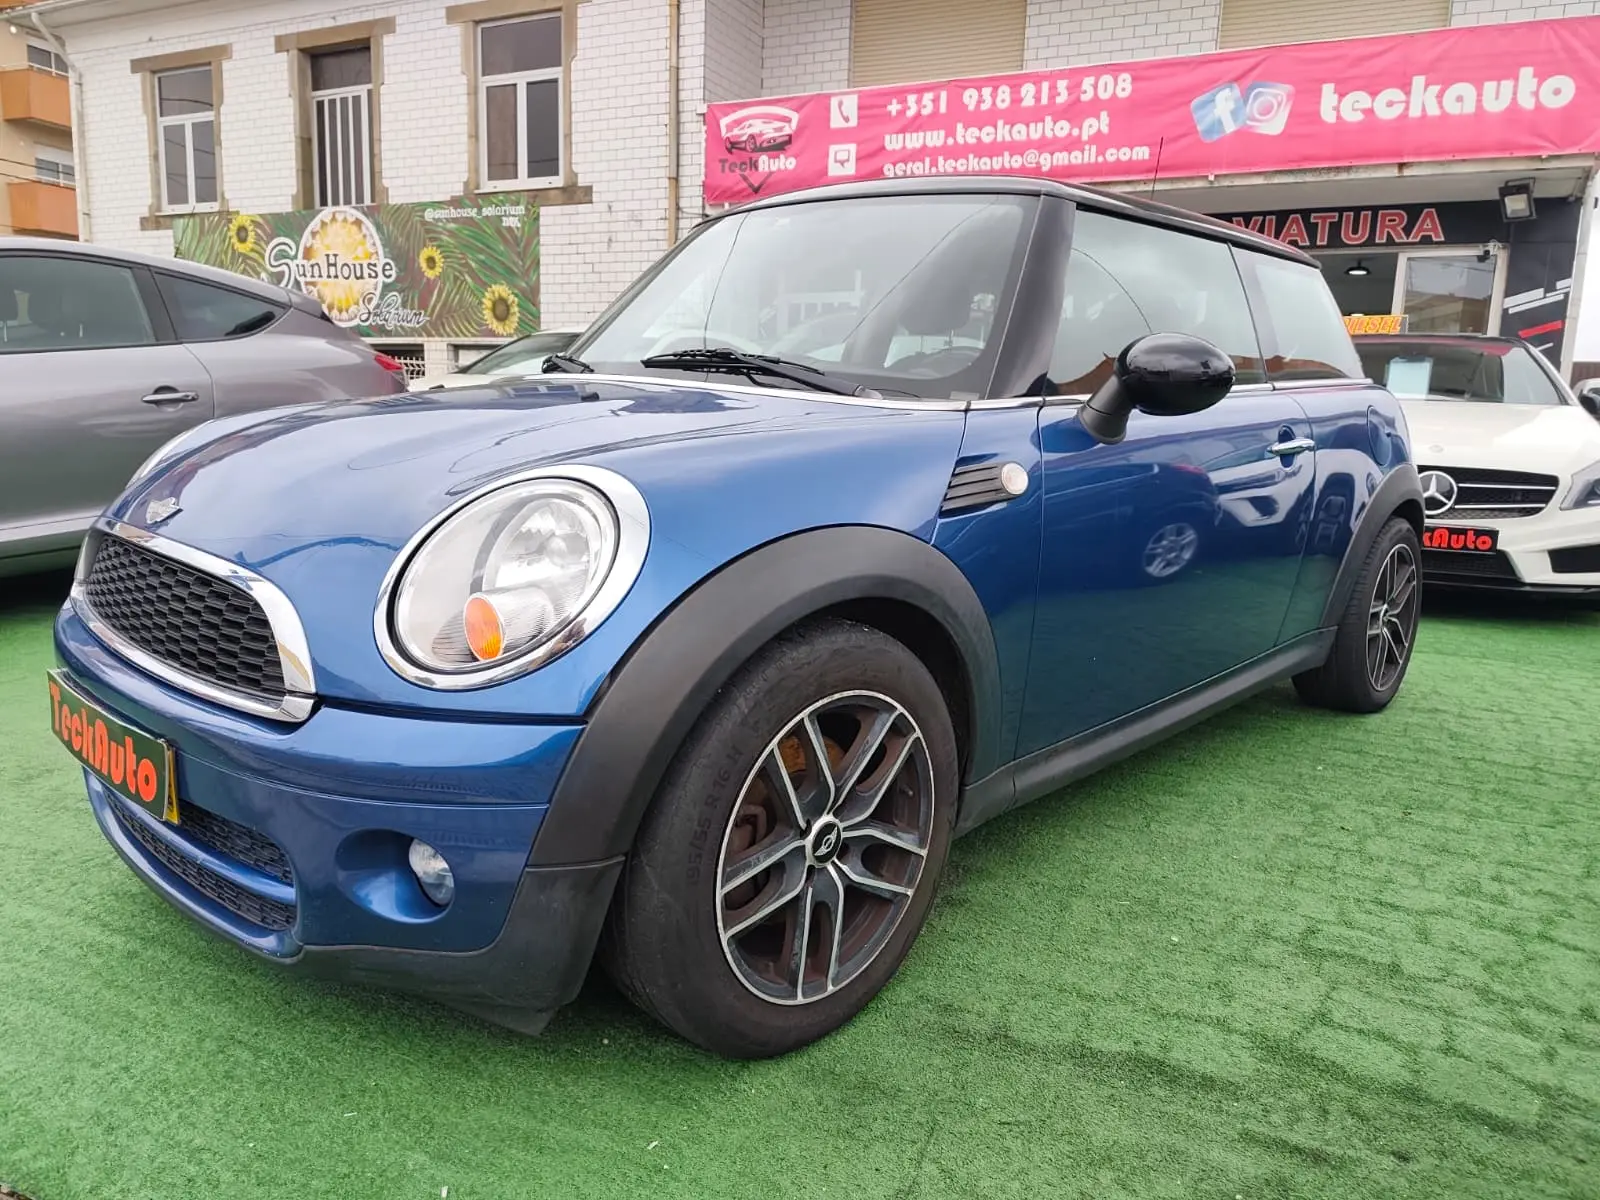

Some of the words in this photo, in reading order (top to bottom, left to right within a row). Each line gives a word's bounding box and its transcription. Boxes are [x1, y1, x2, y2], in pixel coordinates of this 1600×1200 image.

[887, 90, 947, 118] +351
[962, 84, 1011, 112] 938
[1020, 78, 1069, 107] 213
[1080, 73, 1132, 102] 508
[1320, 66, 1576, 124] teckauto
[884, 111, 1110, 151] www.teckauto.pt
[719, 154, 797, 174] TeckAuto
[883, 145, 1150, 177] geral.teckauto@gmail.com
[1232, 208, 1445, 246] VIATURA
[1343, 316, 1402, 334] IESEL
[49, 681, 157, 802] TeckAuto
